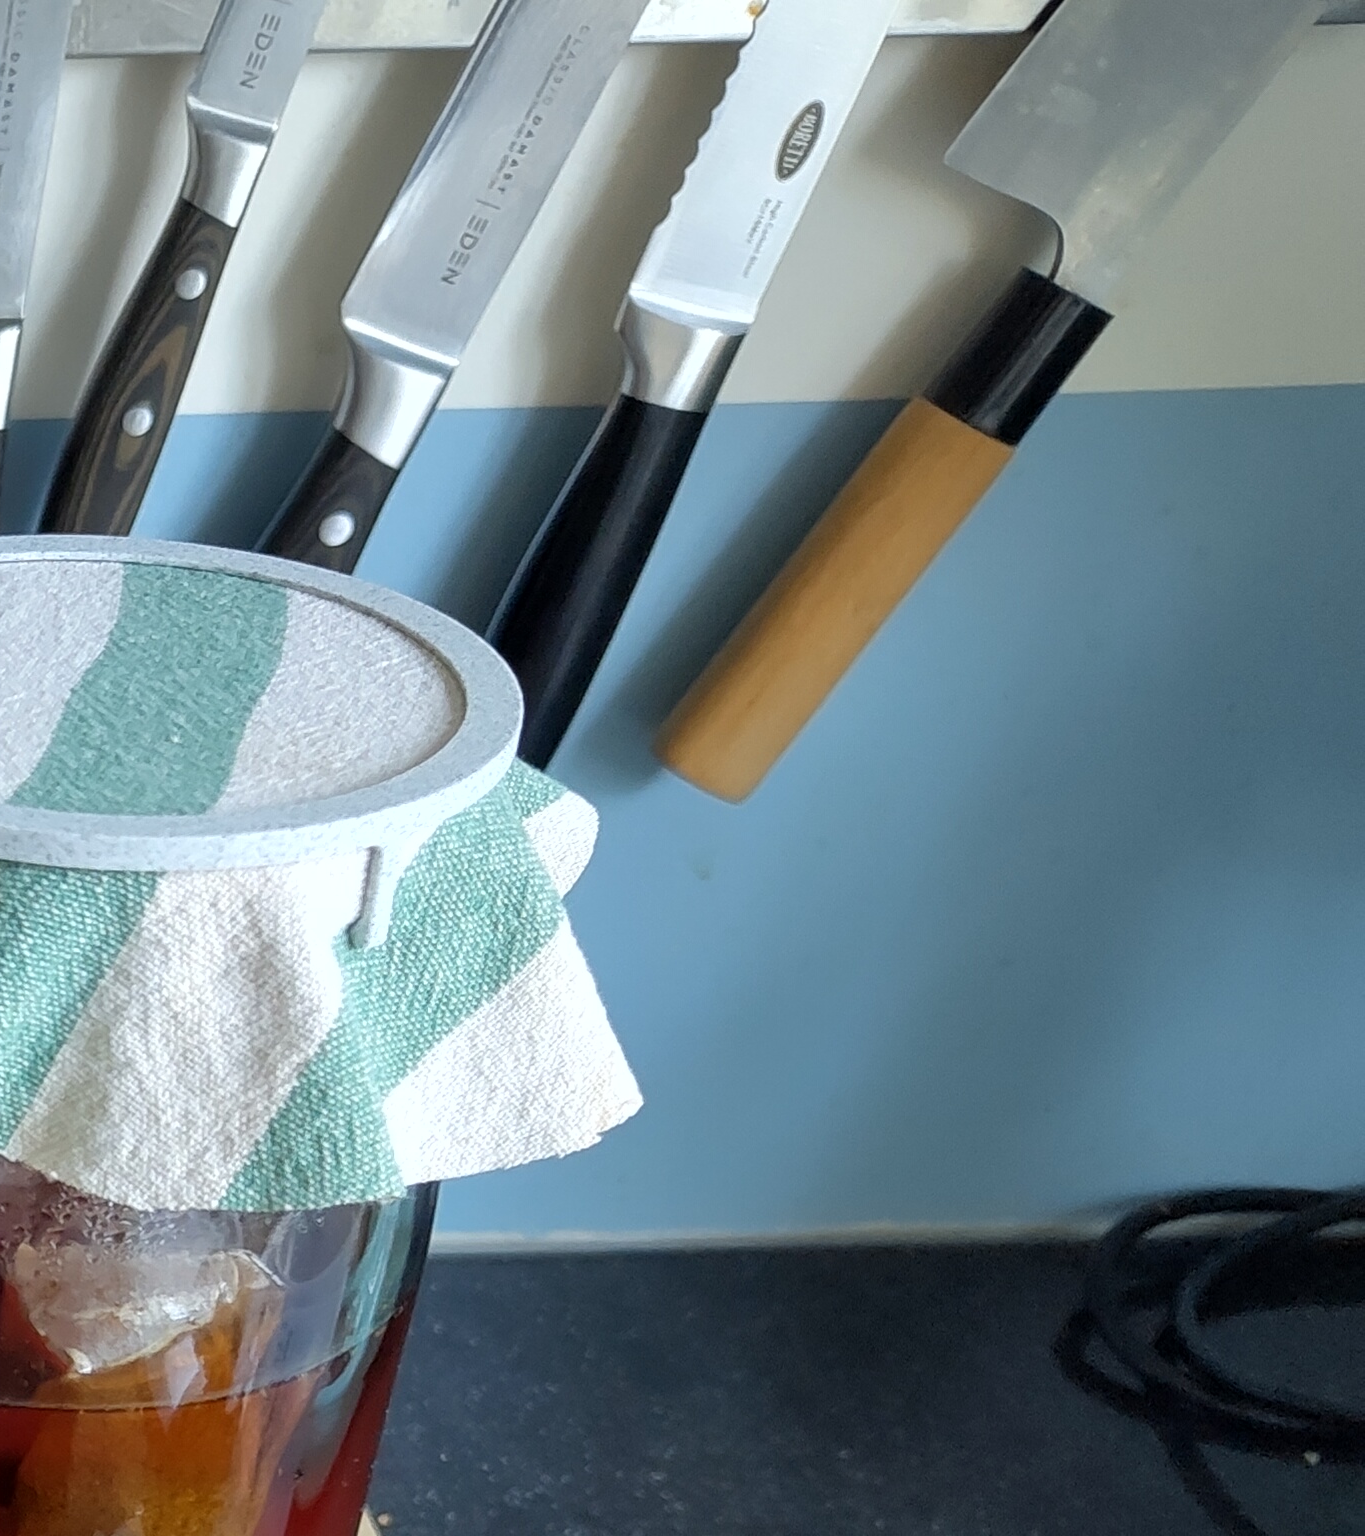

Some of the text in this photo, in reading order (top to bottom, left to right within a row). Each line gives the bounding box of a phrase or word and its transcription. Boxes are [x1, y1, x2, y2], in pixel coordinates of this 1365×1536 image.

[238, 12, 282, 90] EDEN
[0, 52, 21, 135] DAMAST
[497, 114, 544, 195] DAMAST
[784, 111, 820, 172] BORETTI
[440, 213, 490, 286] EDEN
